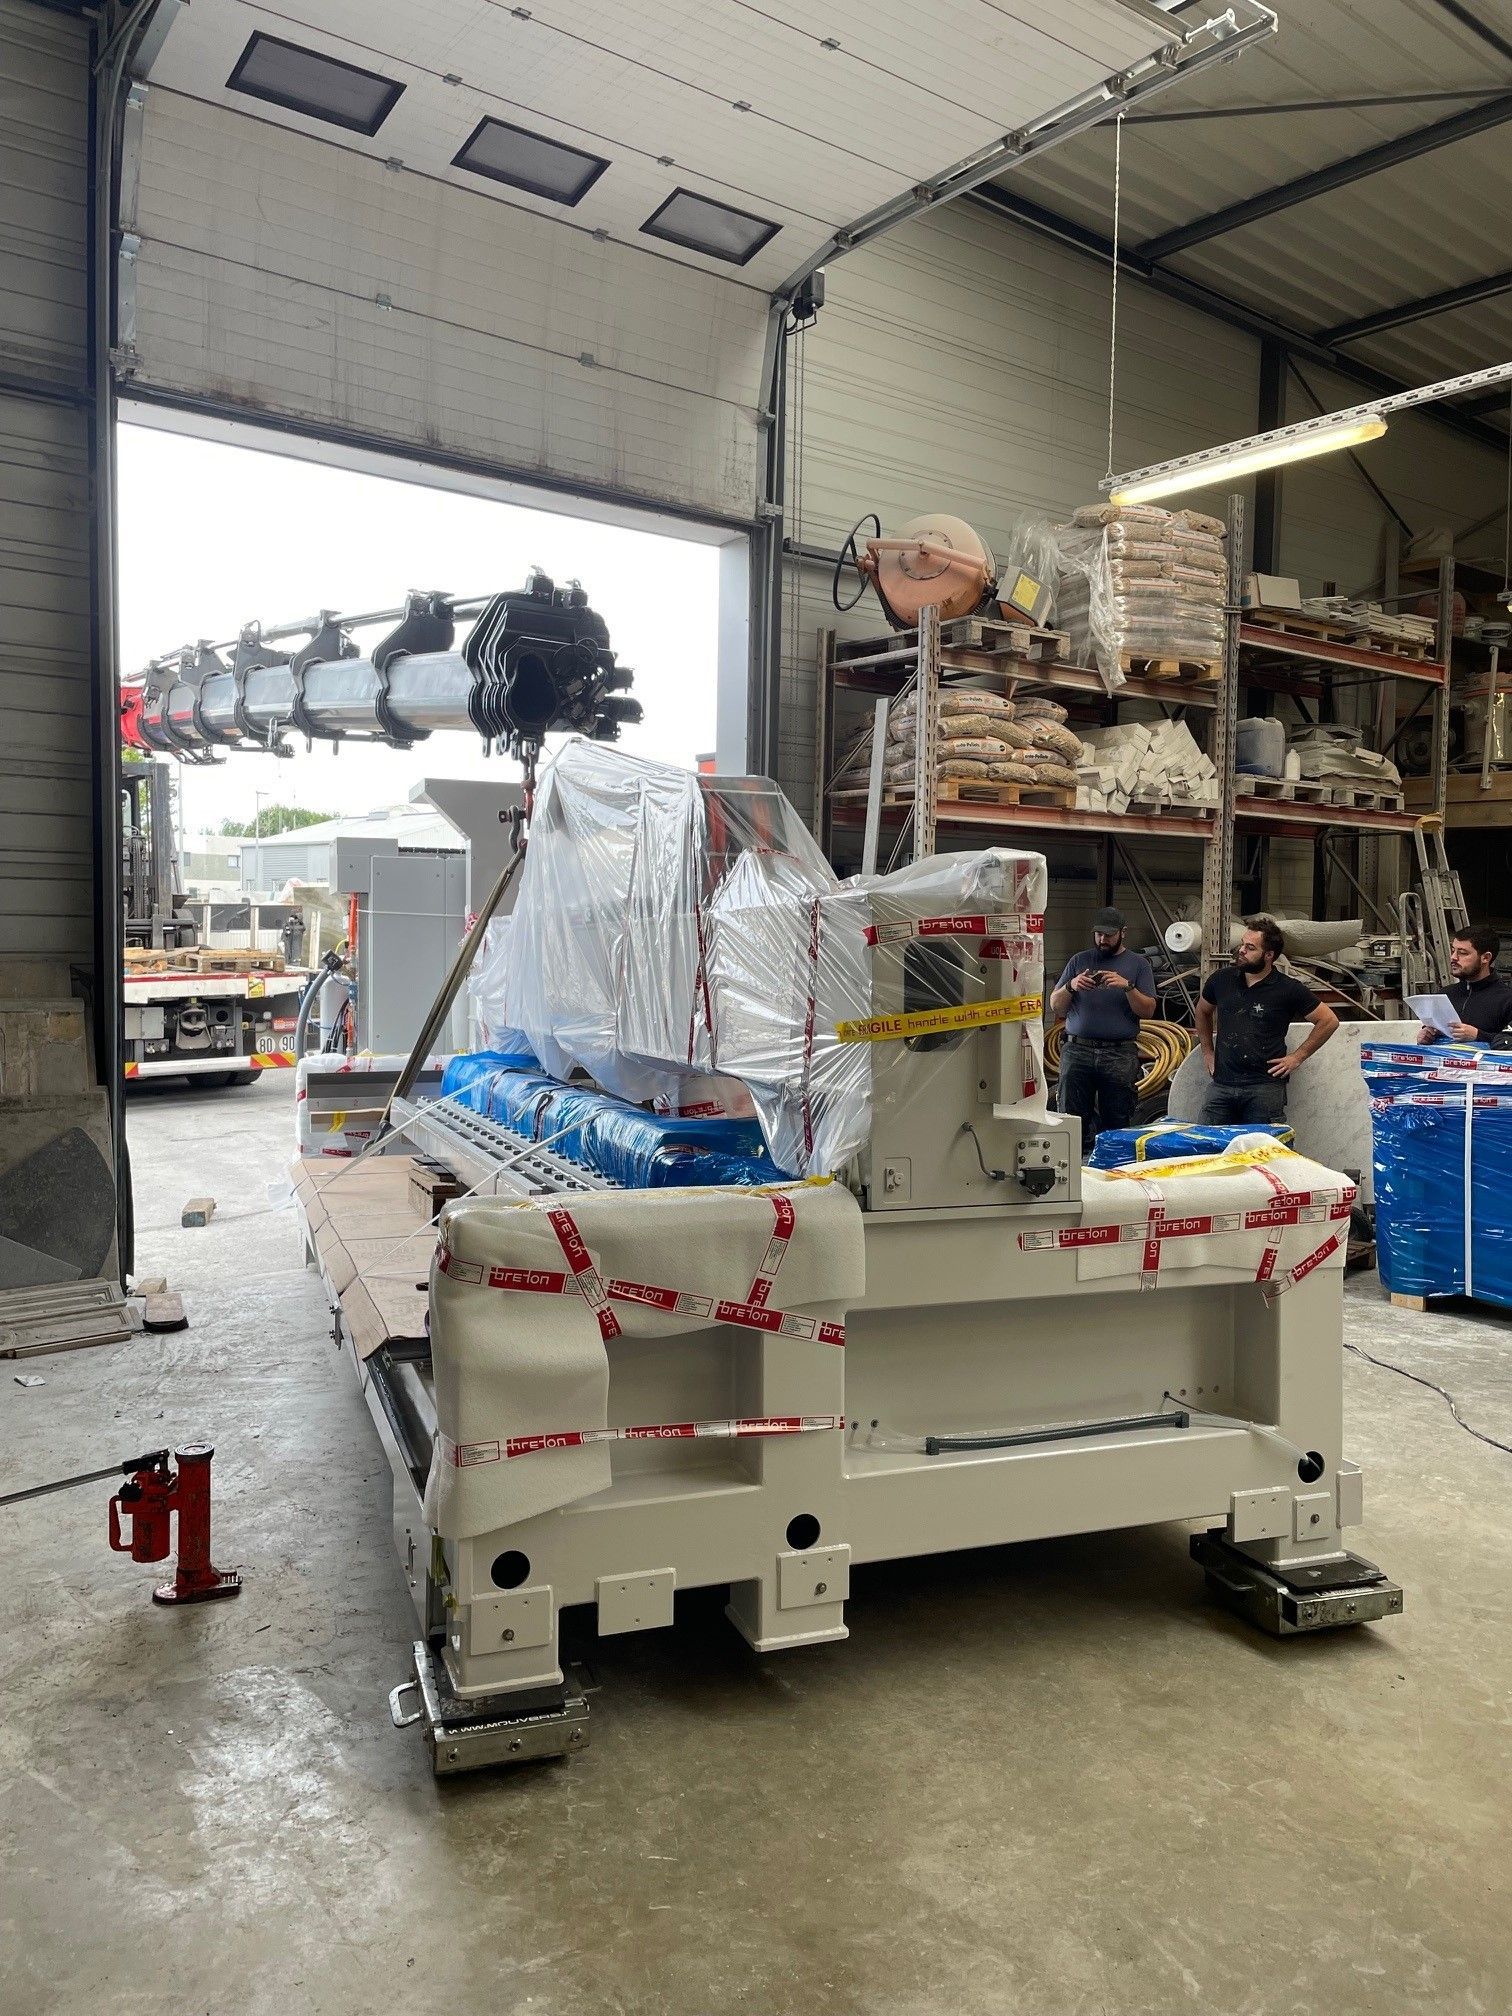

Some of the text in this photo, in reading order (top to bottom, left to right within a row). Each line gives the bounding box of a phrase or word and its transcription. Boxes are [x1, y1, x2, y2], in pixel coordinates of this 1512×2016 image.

[919, 917, 972, 929] breton
[908, 1016, 949, 1027] handle
[954, 1010, 980, 1023] with
[985, 1006, 1012, 1017] care
[260, 1038, 273, 1053] 80
[282, 1036, 295, 1051] 90
[1444, 1059, 1471, 1067] breton
[555, 1209, 586, 1258] breton
[1059, 1227, 1107, 1240] breton
[1156, 1219, 1200, 1231] breton
[1246, 1210, 1287, 1222] breton
[1293, 1246, 1330, 1276] breton
[490, 1267, 549, 1284] breton
[608, 1281, 663, 1301] breton
[719, 1301, 769, 1322] breton
